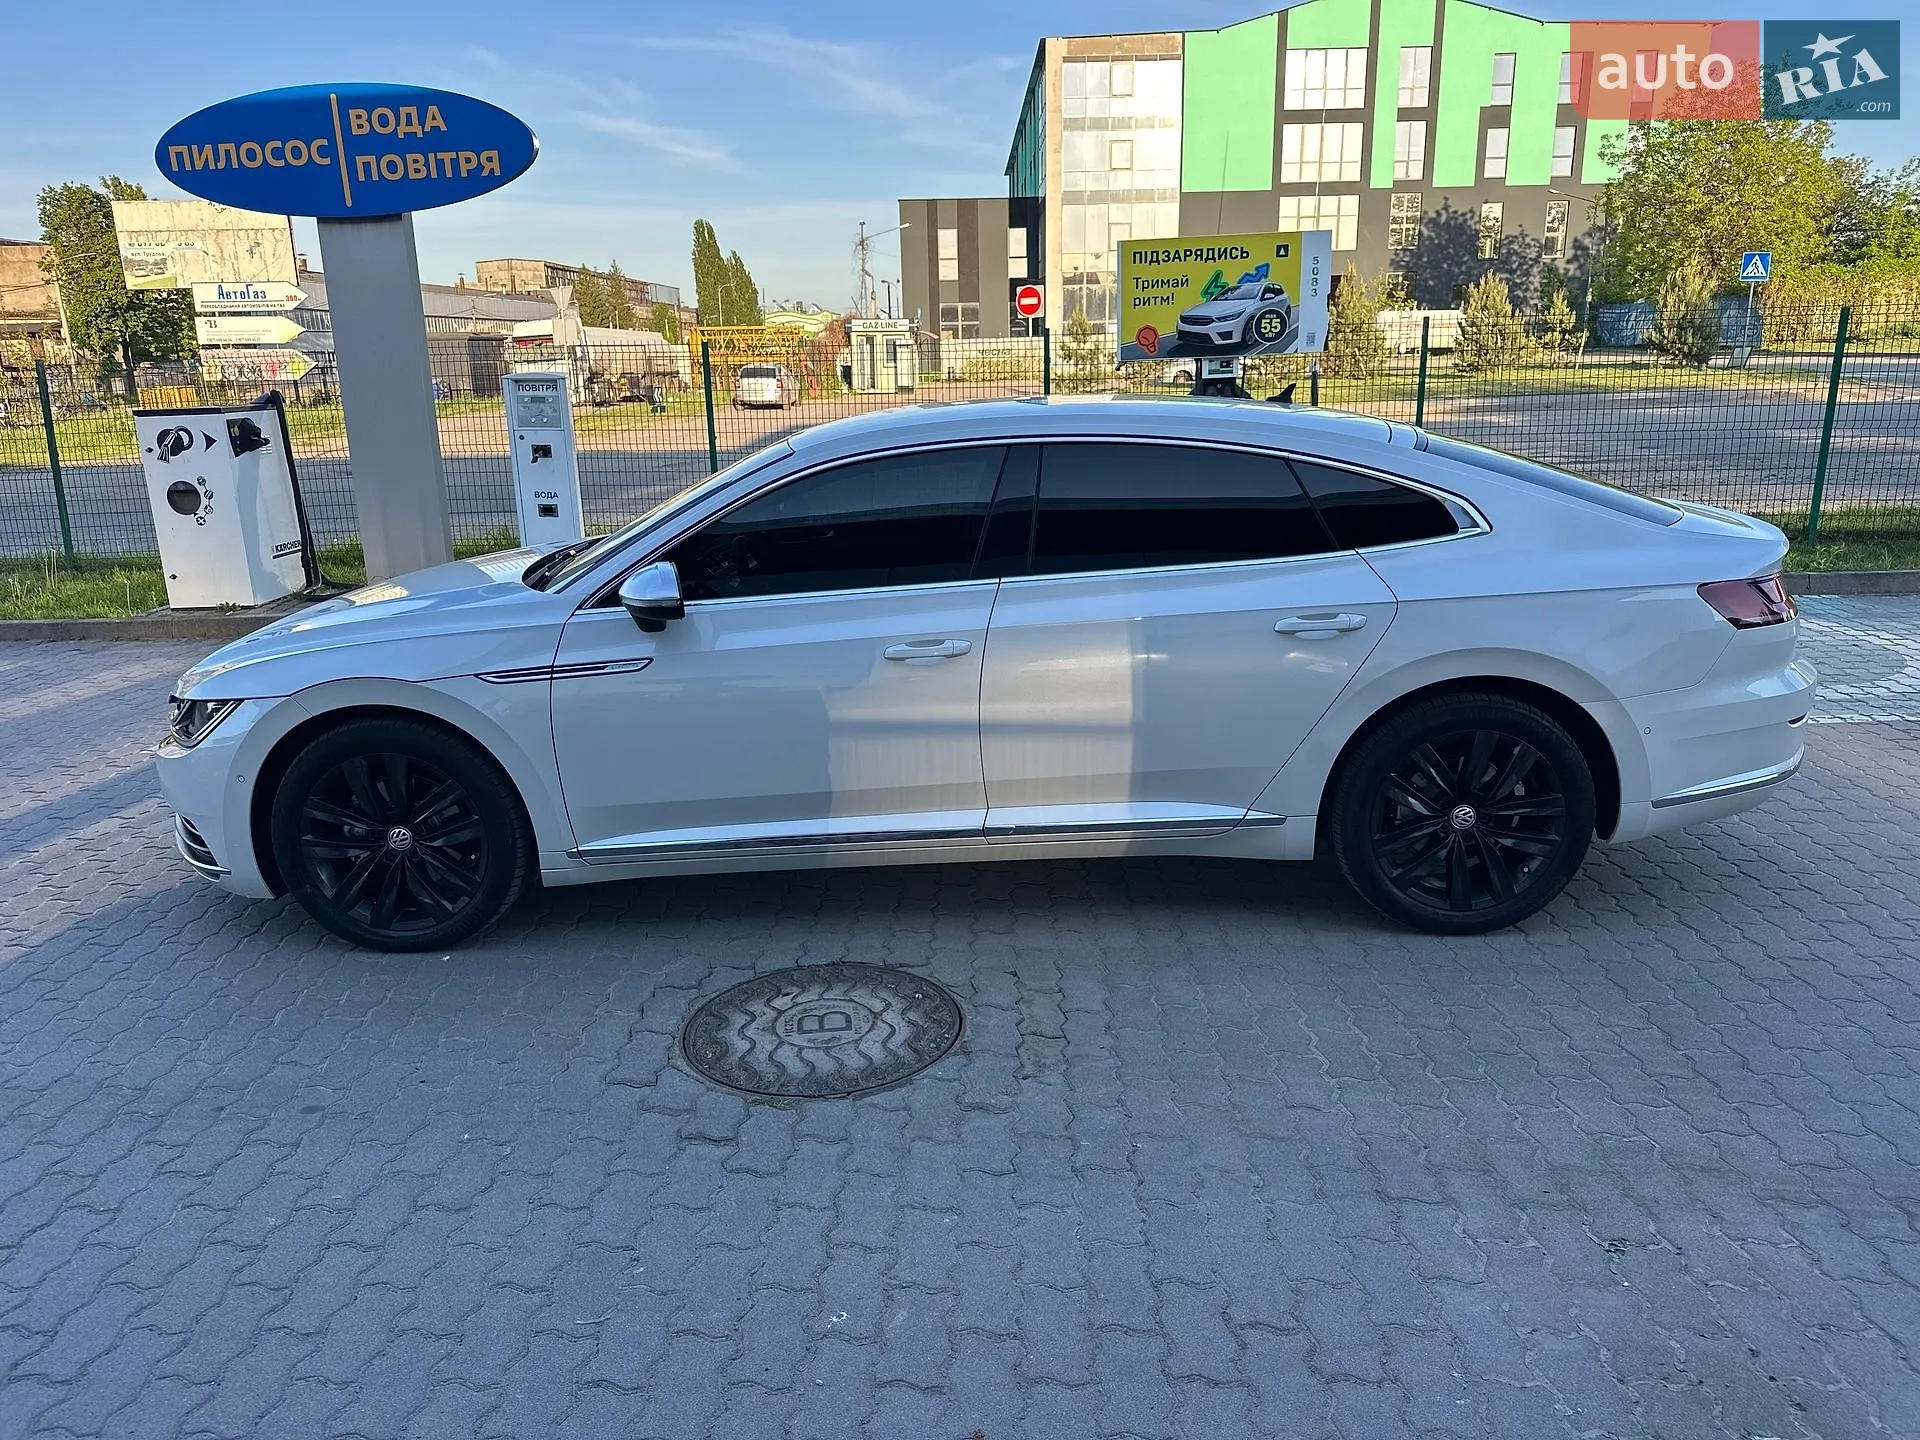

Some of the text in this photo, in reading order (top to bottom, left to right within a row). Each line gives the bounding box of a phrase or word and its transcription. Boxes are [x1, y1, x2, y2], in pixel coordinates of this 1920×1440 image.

[348, 105, 447, 139] ВОДА
[168, 138, 331, 171] ПИЛОСОС
[355, 150, 501, 182] ПОВІТРЯ
[1132, 246, 1250, 266] ПІДЗАРЯДИСЬ
[1132, 274, 1189, 292] Тримай
[217, 284, 267, 300] АвтоГаз
[1133, 293, 1175, 310] ритм!
[1260, 318, 1281, 333] 55
[517, 384, 558, 392] ПОВІТРЯ
[534, 491, 559, 500] ВОДА
